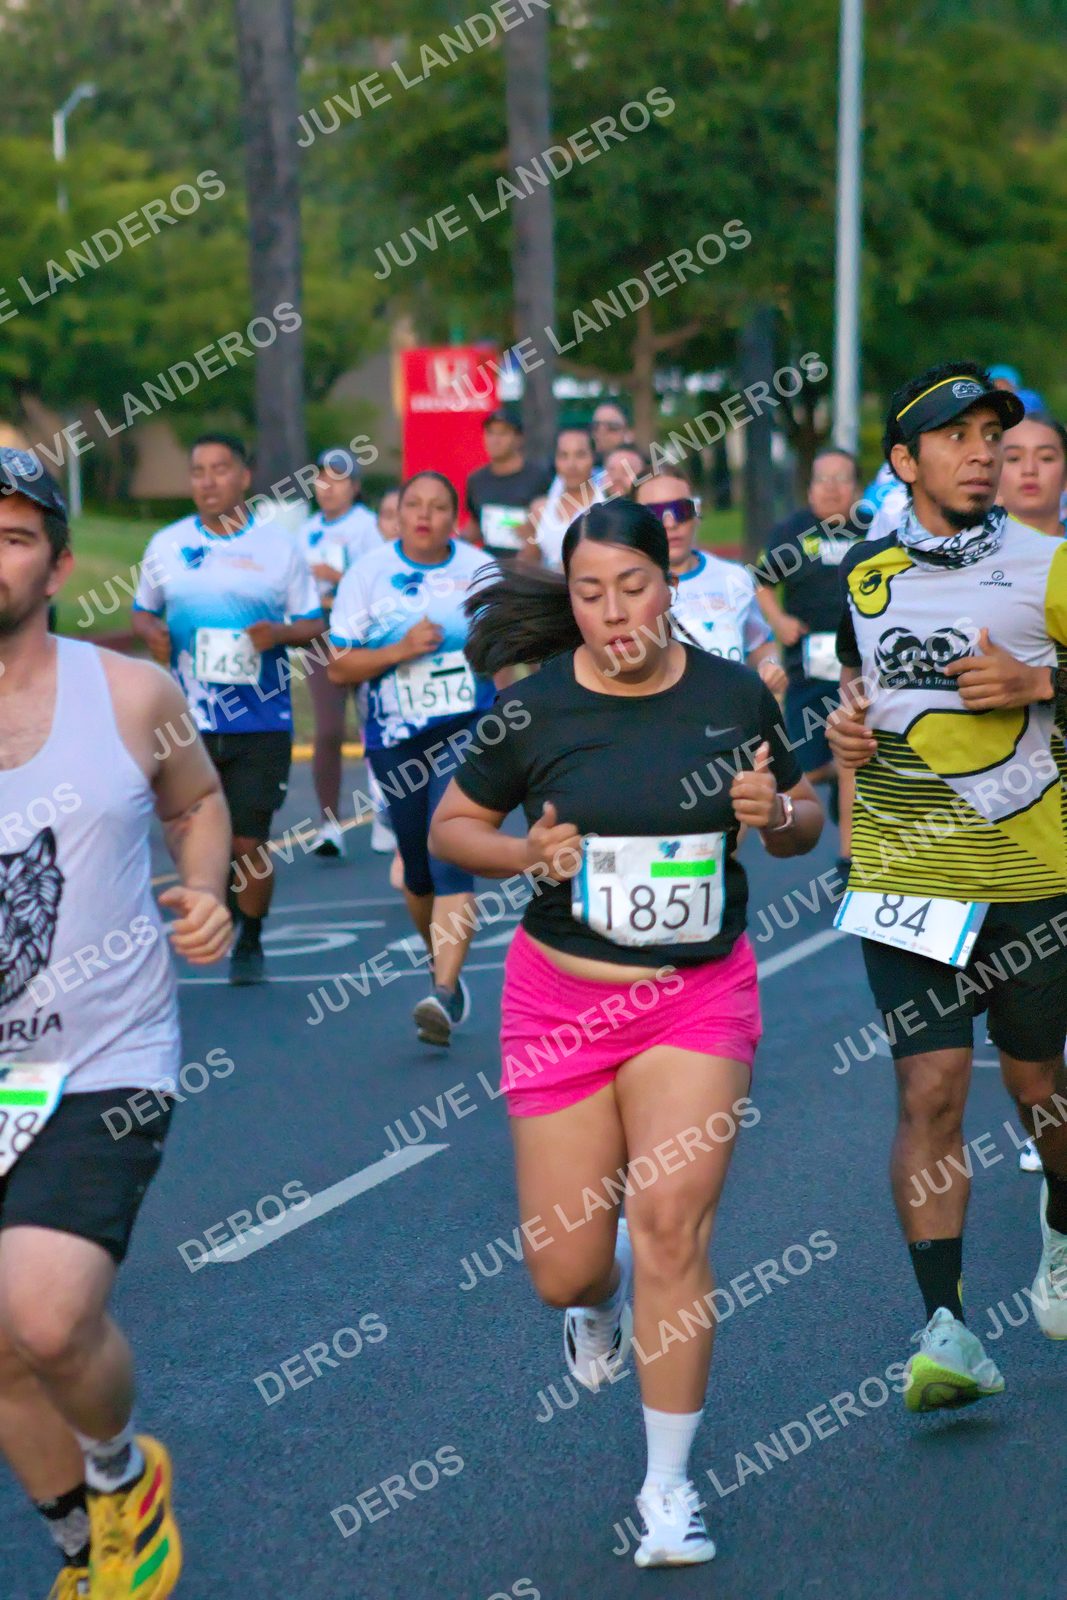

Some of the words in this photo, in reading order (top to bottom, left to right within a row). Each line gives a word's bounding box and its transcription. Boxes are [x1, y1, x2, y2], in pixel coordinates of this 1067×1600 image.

[404, 677, 474, 710] 1516
[599, 882, 711, 932] 1851
[874, 893, 933, 937] 84
